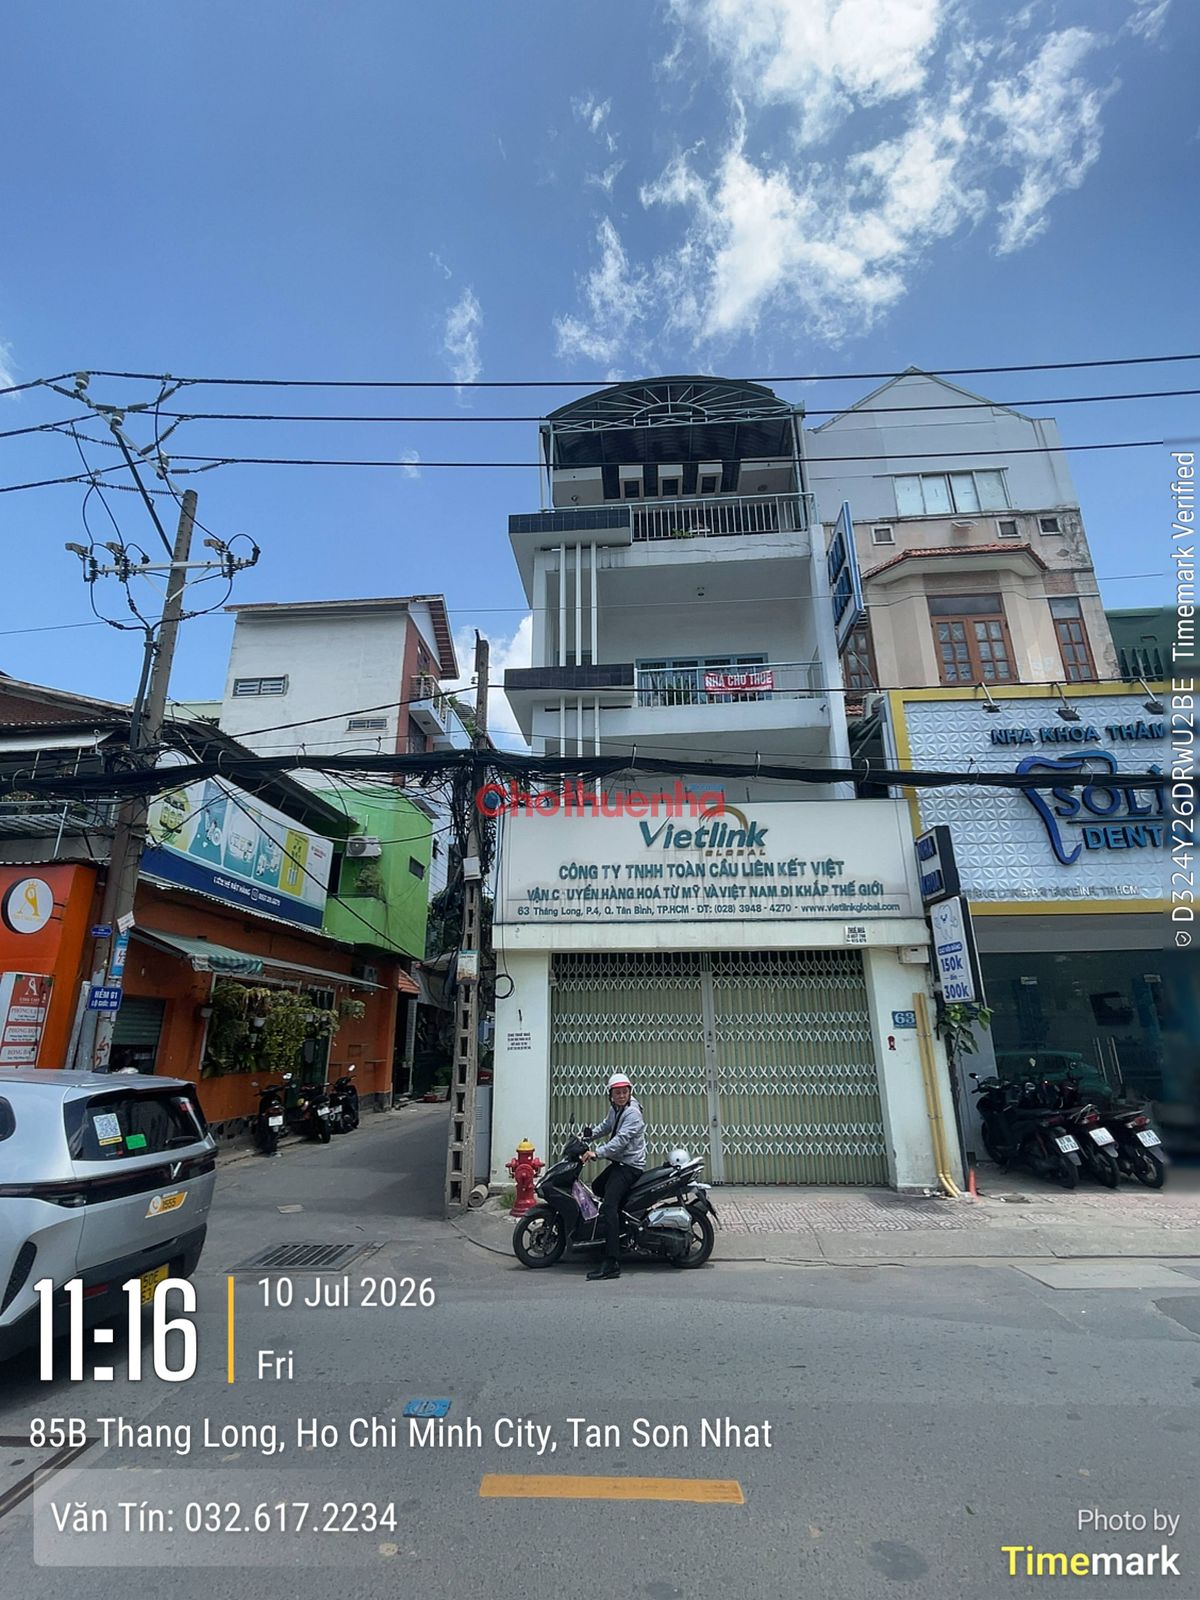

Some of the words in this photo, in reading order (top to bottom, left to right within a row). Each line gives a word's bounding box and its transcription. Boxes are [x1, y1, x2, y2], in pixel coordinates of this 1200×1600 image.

[991, 727, 1035, 745] NHA
[1039, 725, 1102, 744] KHOA
[639, 816, 769, 849] Vietlink
[559, 861, 598, 880] CÔNG
[601, 864, 622, 879] TY
[625, 863, 663, 879] TNHH
[666, 860, 705, 878] TOÀN
[742, 859, 774, 877] LIÊN
[777, 857, 807, 877] KẾT
[811, 859, 845, 879] VIỆT
[527, 886, 549, 903] VẬN
[601, 885, 635, 899] HÀNG
[637, 885, 661, 899] HOÁ
[663, 884, 680, 899] TỪ
[703, 883, 719, 898] VÀ
[719, 883, 746, 901] VIỆT
[749, 885, 778, 898] NAM
[780, 884, 793, 897] ĐI
[831, 879, 856, 896] THẾ
[858, 880, 884, 896] GIỚI
[517, 906, 530, 915] 63
[604, 905, 614, 915] Q.
[657, 905, 689, 914] TP.HCM
[714, 903, 736, 914] (028)
[739, 904, 762, 913] 3948
[769, 903, 792, 913] 4270
[941, 955, 963, 972] 150k
[944, 982, 969, 999] 300k
[894, 1012, 915, 1024] 63
